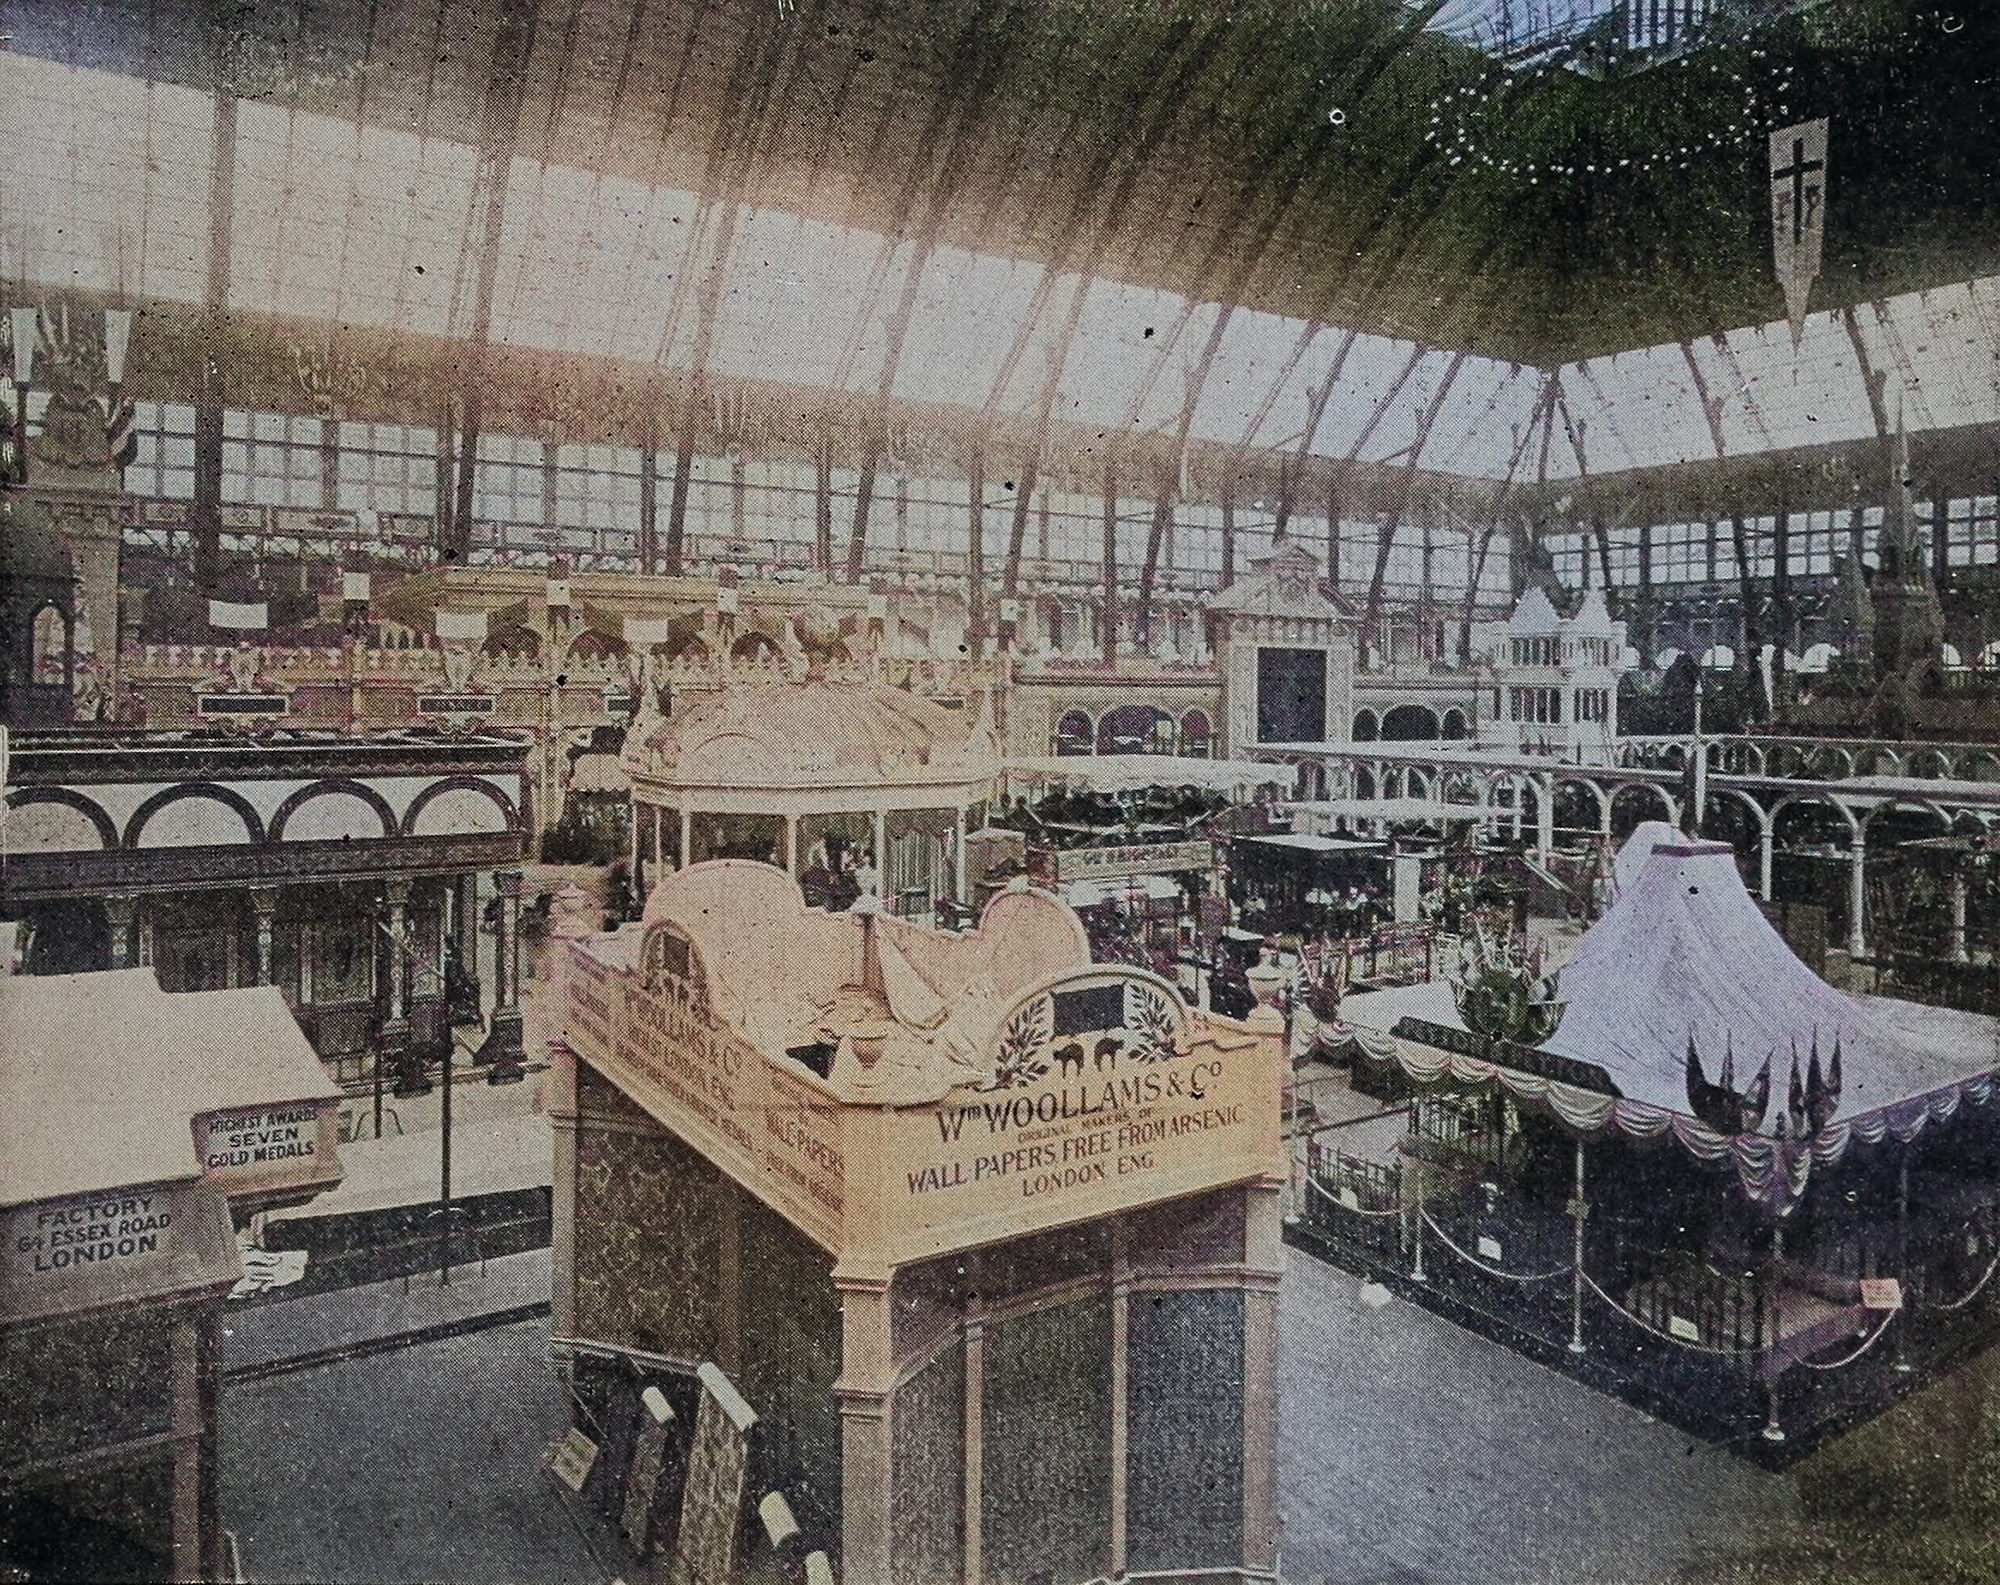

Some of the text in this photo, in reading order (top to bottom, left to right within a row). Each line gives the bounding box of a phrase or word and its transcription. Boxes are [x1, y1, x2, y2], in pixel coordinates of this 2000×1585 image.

[984, 1071, 1162, 1133] WOOLLAMS
[1167, 1071, 1185, 1098] &
[228, 1126, 299, 1148] SEVEN
[1063, 1130, 1113, 1162] FREE
[1118, 1118, 1165, 1149] FROM
[1169, 1103, 1246, 1138] ARSENIC
[207, 1139, 315, 1168] GOLD MEDALS
[1022, 1151, 1155, 1197] LONDON ENG
[37, 1195, 153, 1229] FACTORY
[51, 1223, 112, 1248] ESSEX
[118, 1213, 171, 1236] ROAD
[34, 1233, 157, 1272] LONDON
